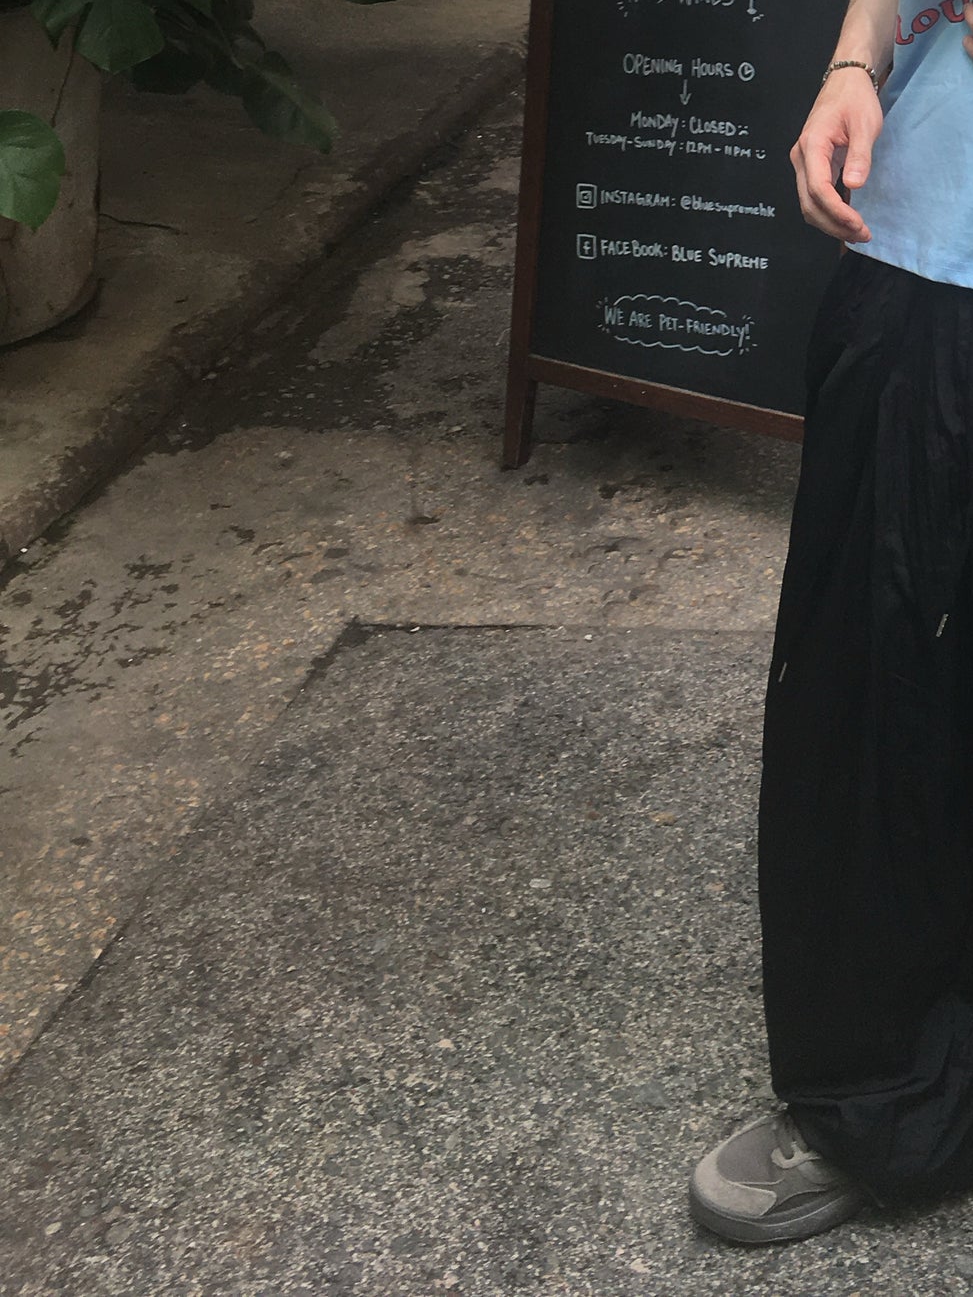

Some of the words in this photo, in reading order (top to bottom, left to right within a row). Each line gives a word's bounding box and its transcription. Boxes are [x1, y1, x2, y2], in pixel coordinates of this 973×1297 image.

[623, 53, 683, 77] OPENING
[692, 58, 734, 78] HOURS
[689, 116, 737, 136] CLOSED
[672, 245, 702, 262] BLUE
[708, 248, 769, 269] SUPREME
[604, 305, 624, 326] WE
[629, 310, 653, 329] ARE
